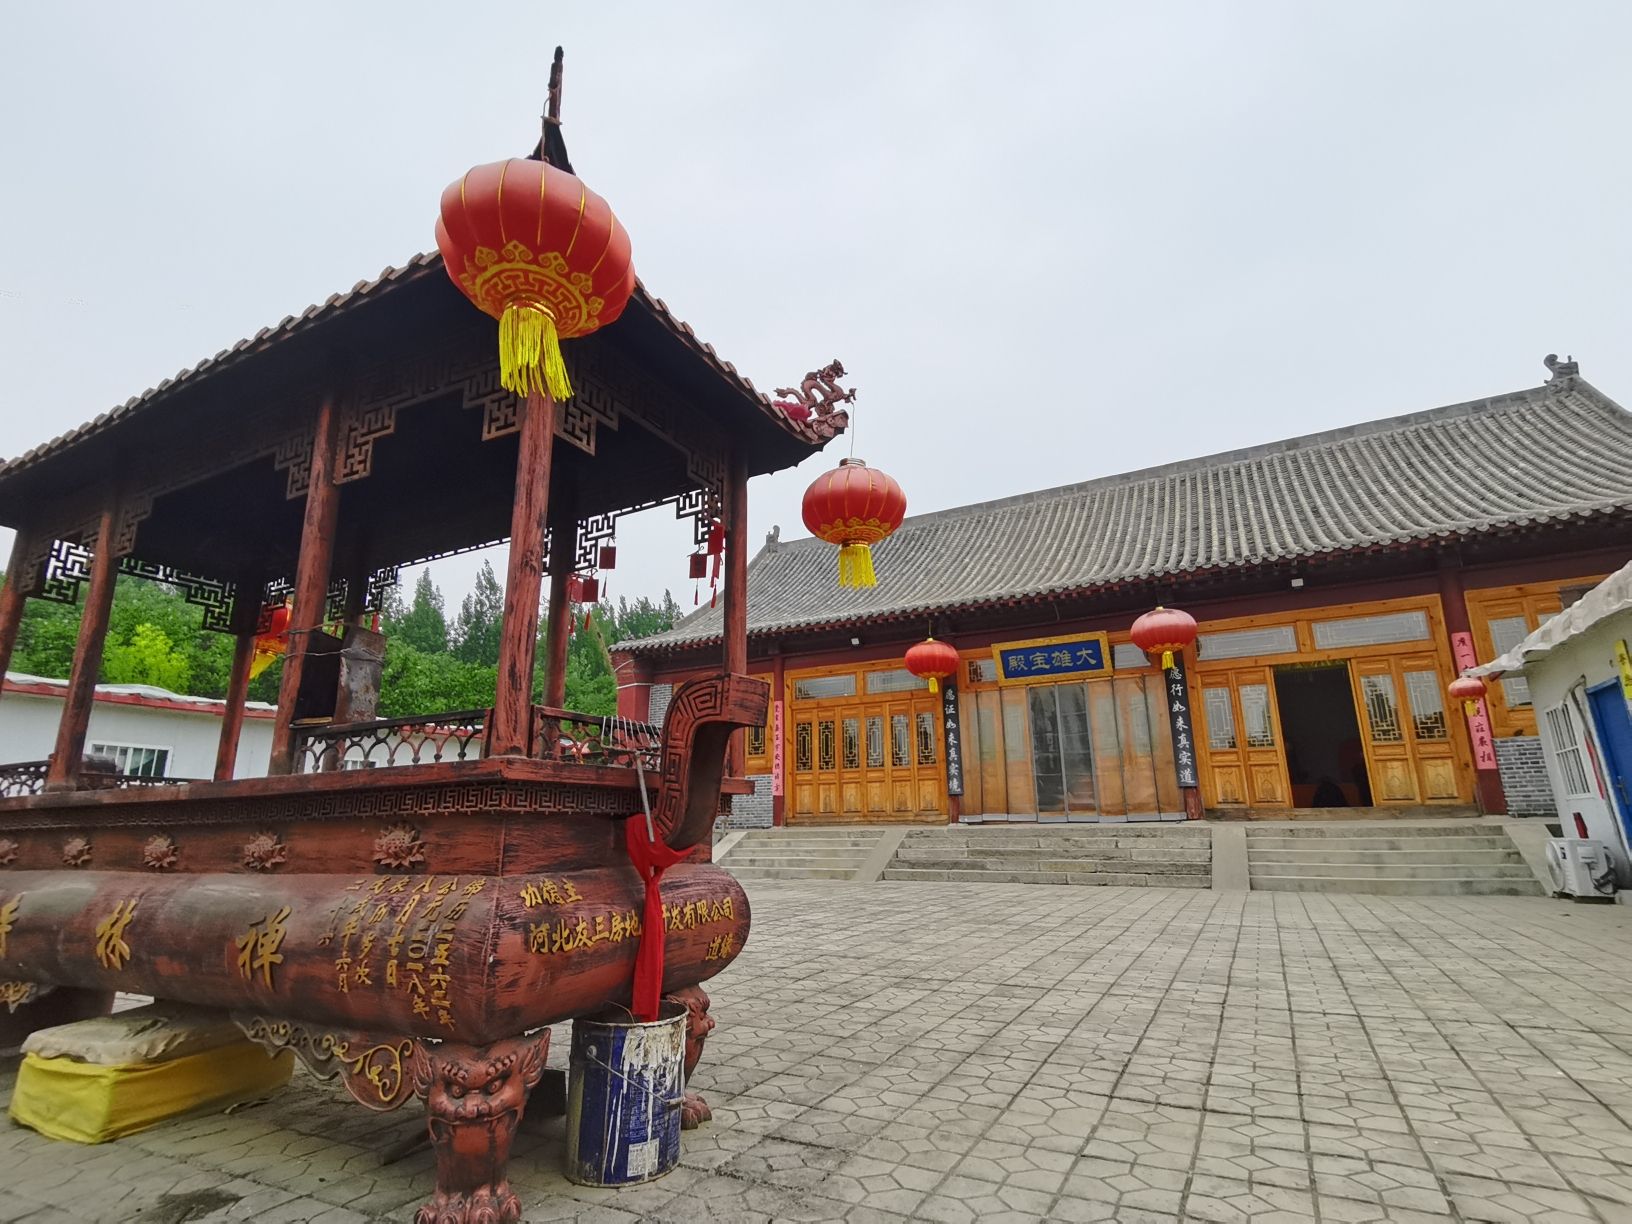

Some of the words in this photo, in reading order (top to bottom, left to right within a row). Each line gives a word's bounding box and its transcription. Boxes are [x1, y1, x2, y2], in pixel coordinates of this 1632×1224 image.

[1007, 648, 1097, 671] 大雄宝殿
[520, 877, 583, 908] 功德主
[530, 896, 734, 954] 河北友三房地开发有限公司
